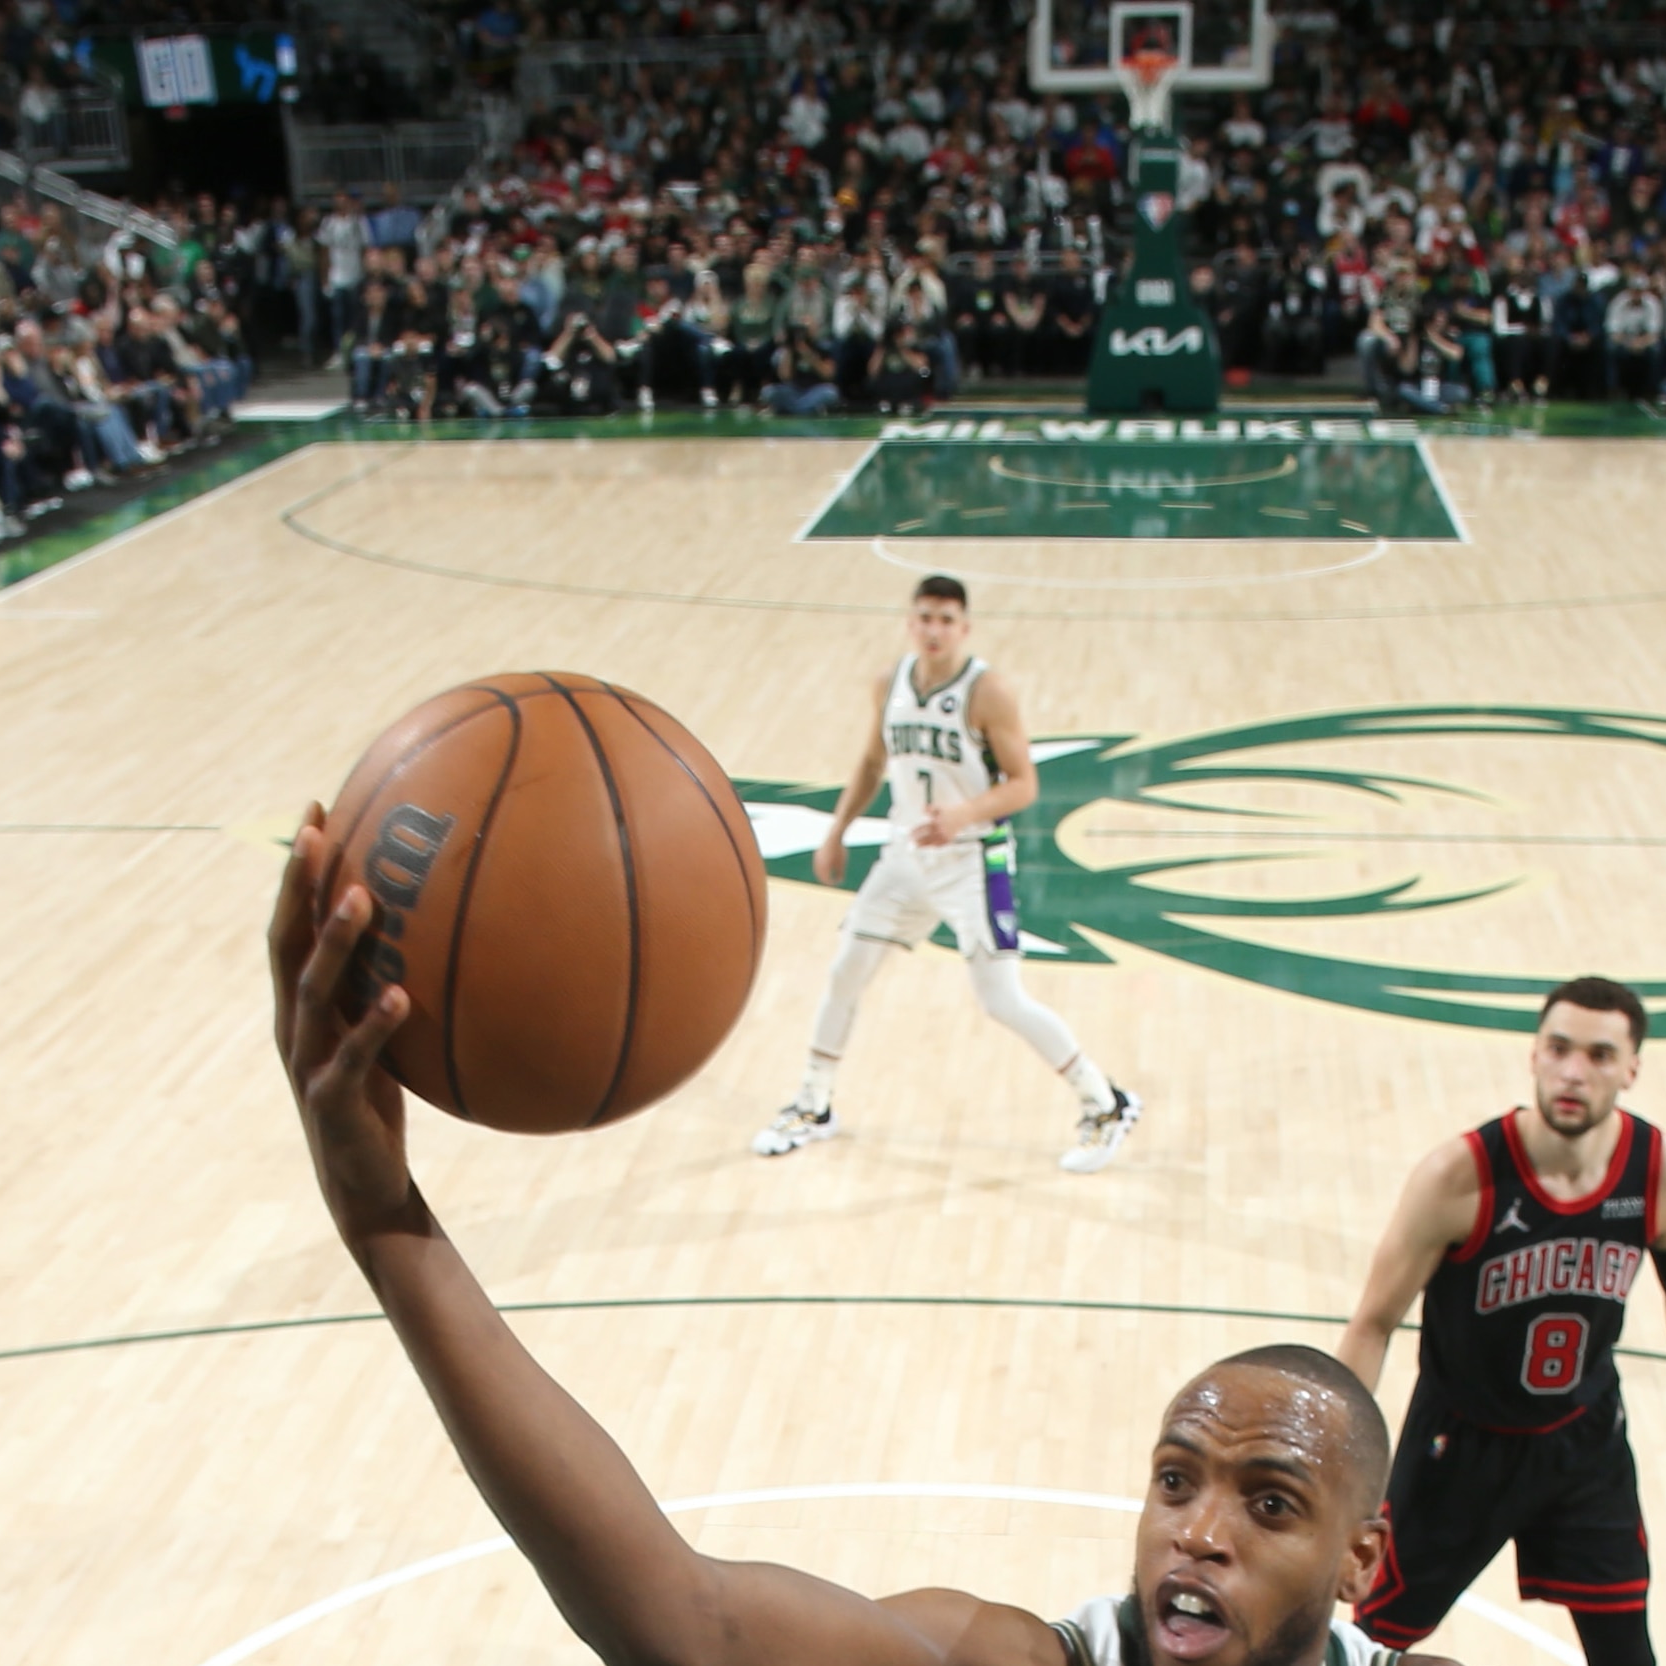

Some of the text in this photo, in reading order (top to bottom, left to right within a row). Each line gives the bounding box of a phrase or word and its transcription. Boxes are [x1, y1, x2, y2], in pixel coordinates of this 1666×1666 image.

[877, 419, 1421, 441] MILWAUKEE
[1476, 1237, 1644, 1315] CHICAGO
[1520, 1312, 1590, 1395] 8
